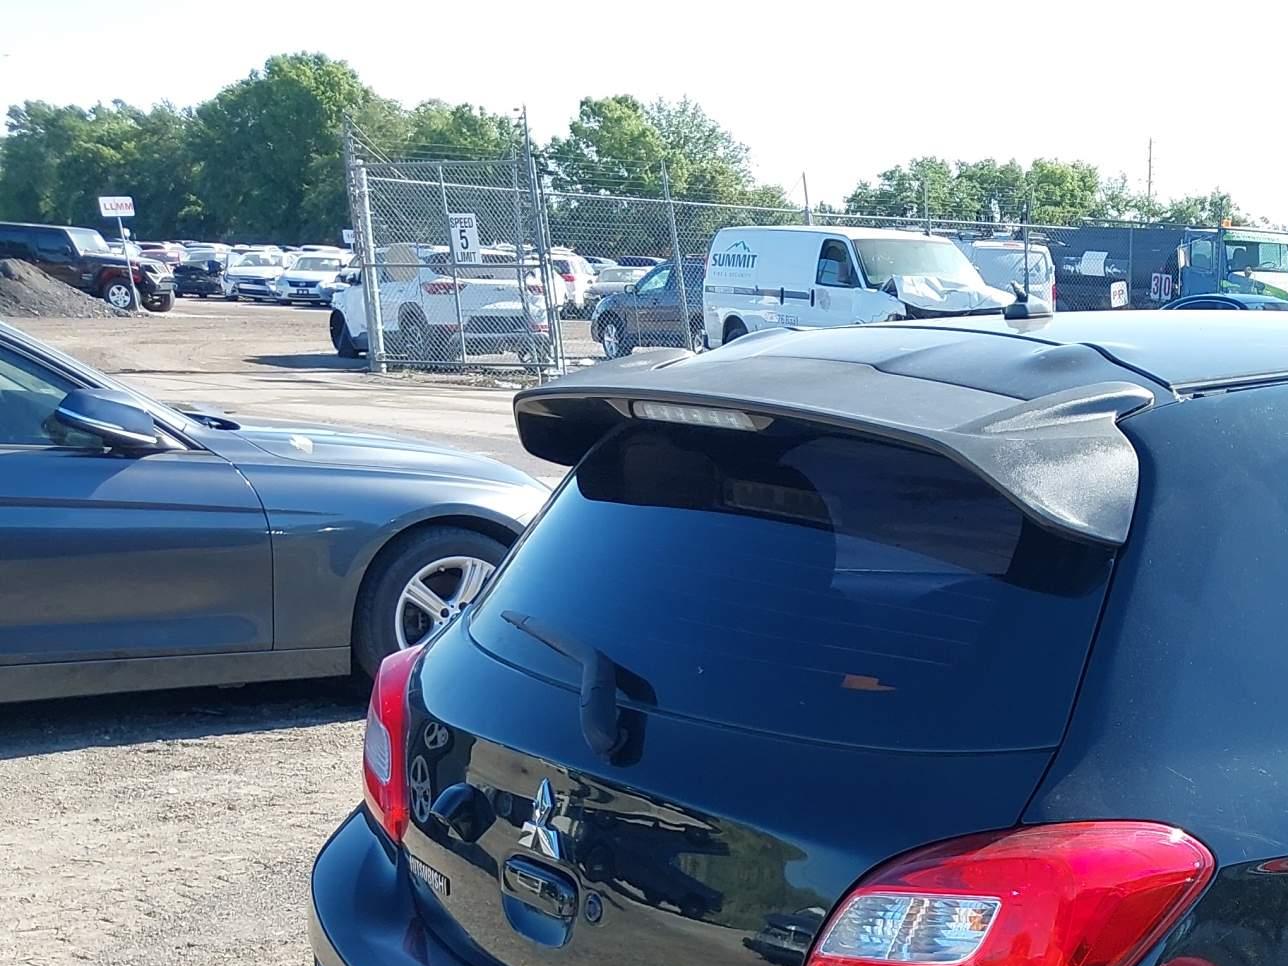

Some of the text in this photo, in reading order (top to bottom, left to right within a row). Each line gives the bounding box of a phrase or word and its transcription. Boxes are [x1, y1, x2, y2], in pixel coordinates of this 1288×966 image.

[450, 217, 474, 229] SPEED
[459, 229, 469, 250] 5
[455, 251, 477, 263] LIMIT
[711, 253, 758, 269] SUMMIT
[1152, 275, 1172, 297] 30
